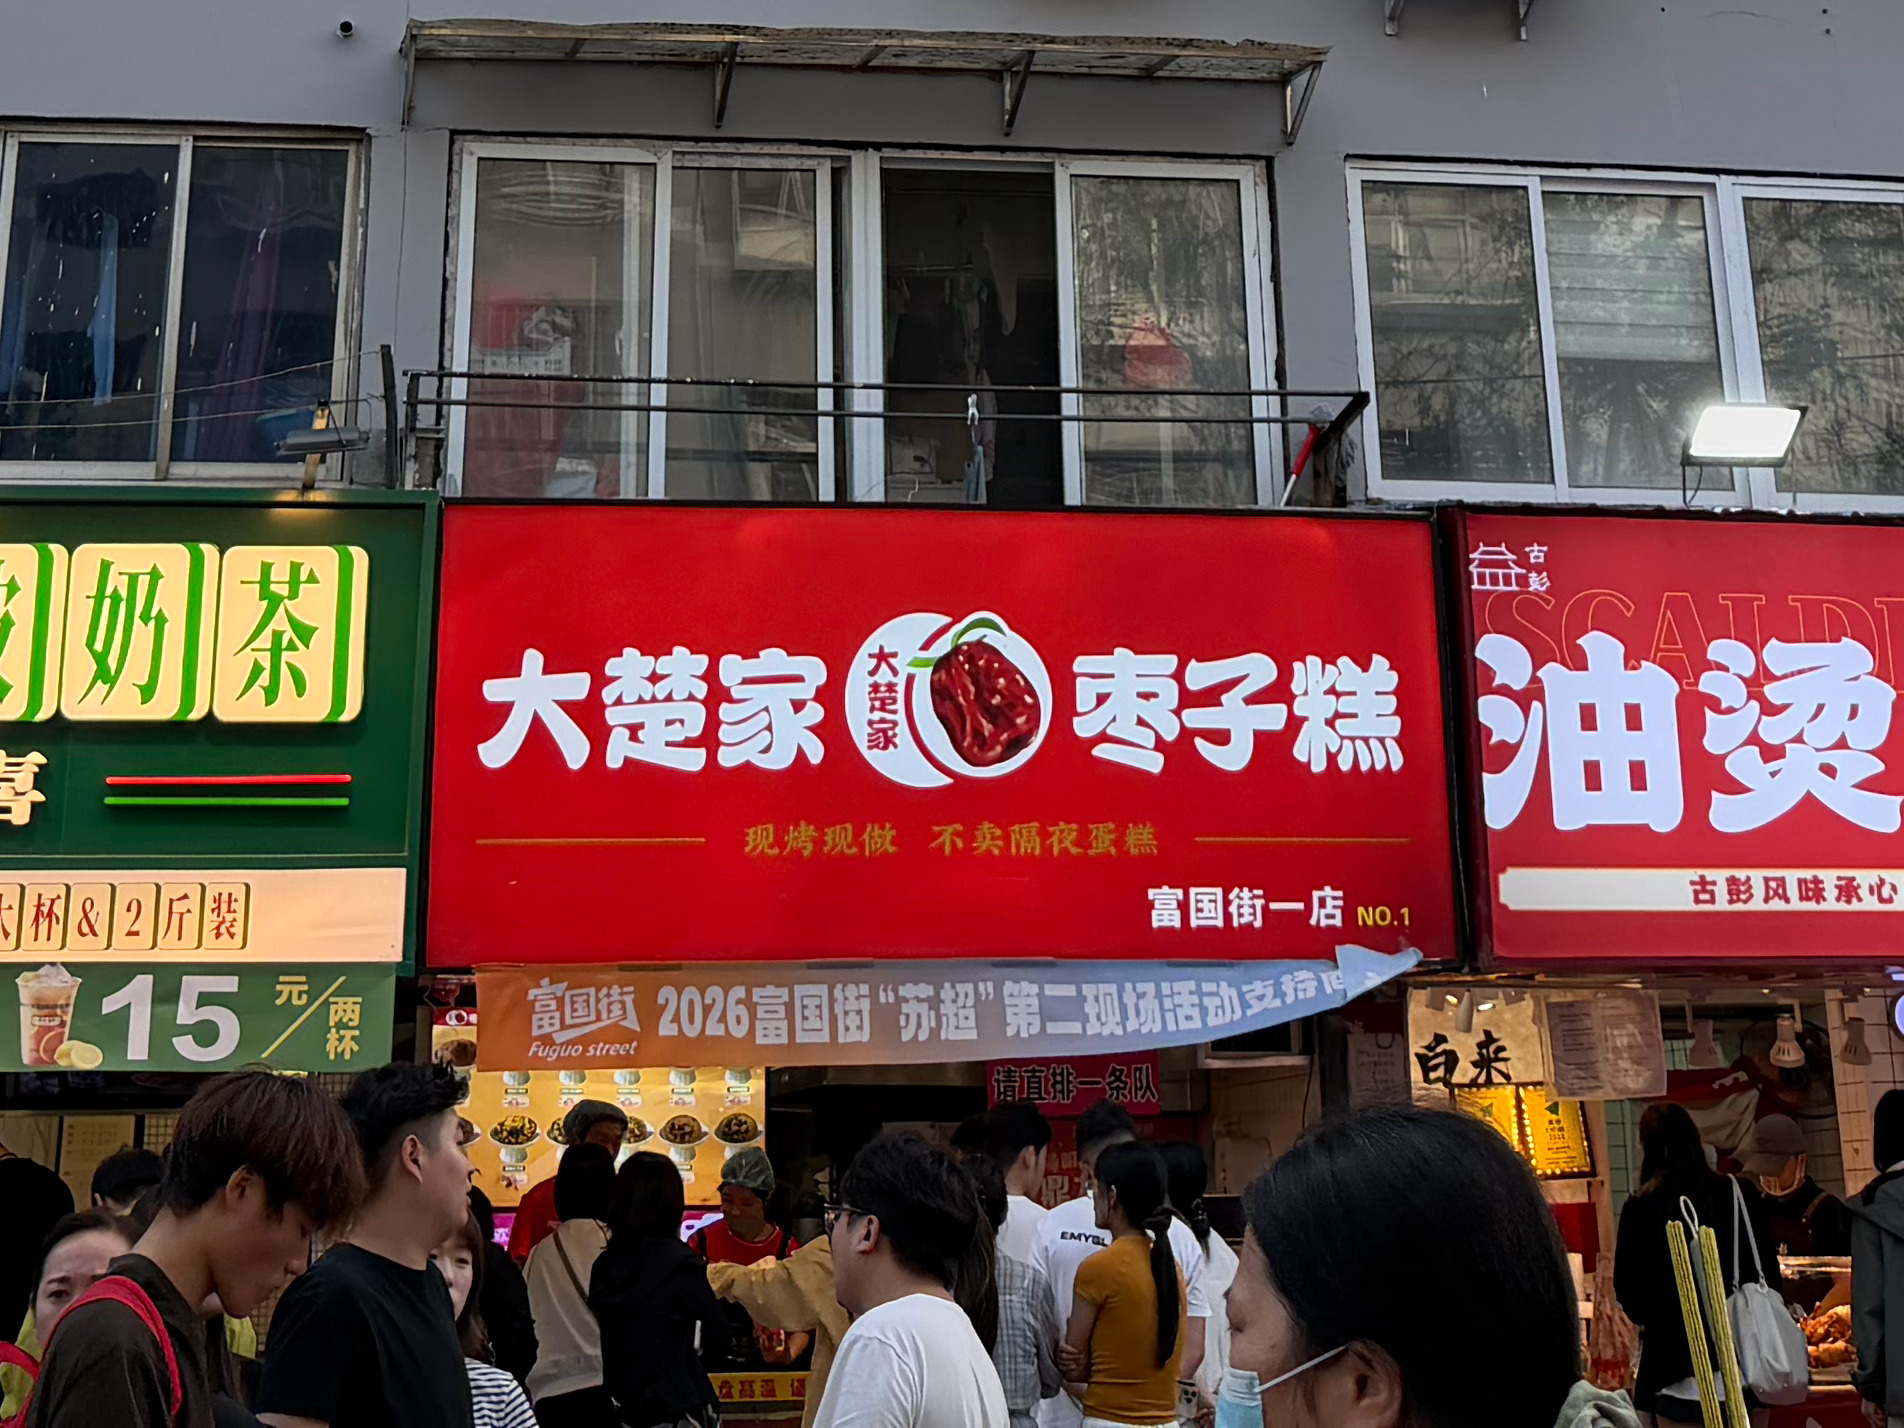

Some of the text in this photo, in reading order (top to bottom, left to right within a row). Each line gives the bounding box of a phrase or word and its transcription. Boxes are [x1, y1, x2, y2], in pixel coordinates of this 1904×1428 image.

[1524, 543, 1551, 592] 古彭
[477, 647, 1403, 775] 大楚家 枣子糕
[867, 644, 900, 752] 大楚家
[743, 820, 1159, 858] 现烤现做 不卖隔夜蛋糕
[1146, 885, 1412, 930] 富国街一店 NO.1
[100, 974, 243, 1062] 15
[527, 977, 641, 1042] 富国街
[527, 1041, 639, 1062] Fuguo street
[992, 1063, 1159, 1105] 请直排一条队
